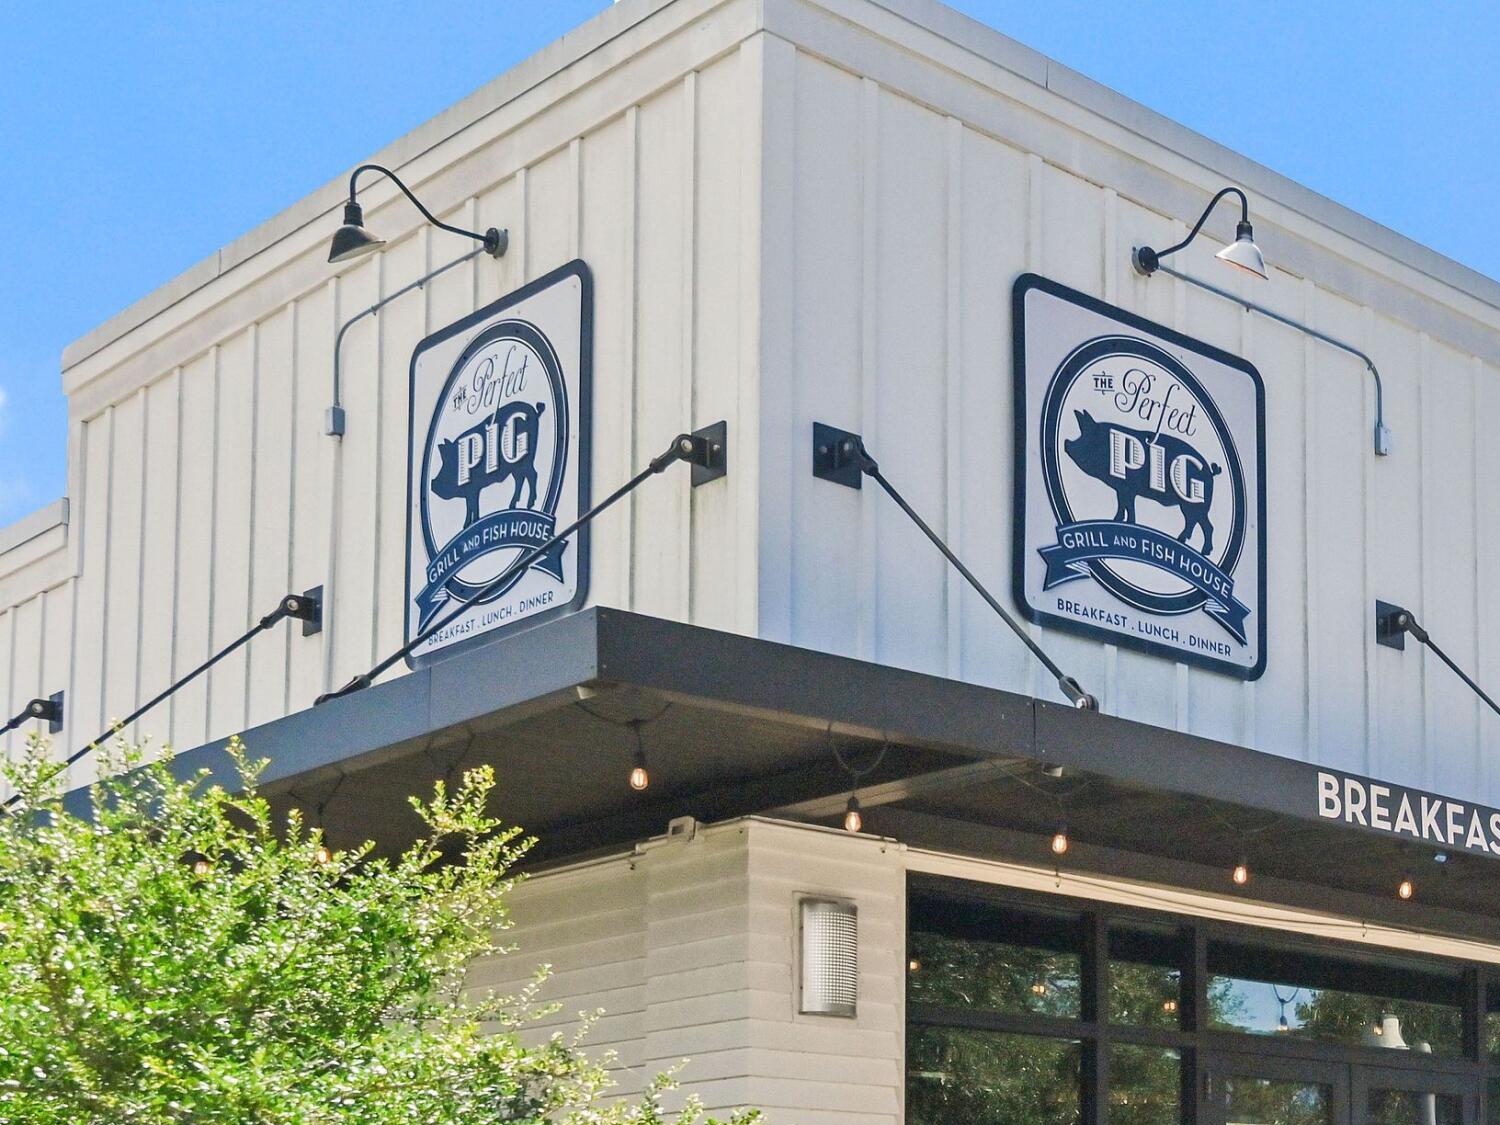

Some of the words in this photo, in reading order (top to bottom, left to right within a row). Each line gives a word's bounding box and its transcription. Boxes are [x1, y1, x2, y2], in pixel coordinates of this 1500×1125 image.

[453, 389, 467, 408] THE
[467, 345, 528, 430] Perfect
[1093, 377, 1114, 389] THE
[1114, 368, 1197, 444] Perfect
[458, 412, 529, 486] PIG
[1109, 428, 1205, 503] PIG
[429, 548, 460, 583] GRILL
[463, 535, 480, 553] AND
[483, 523, 508, 544] FISH
[510, 520, 550, 541] HOUSE
[1063, 531, 1109, 549] GRILL
[1113, 536, 1137, 549] AND
[1142, 539, 1175, 564] FISH
[1180, 556, 1231, 599] HOUSE
[428, 619, 476, 646] BREAKFAST
[482, 605, 512, 626] LUNCH
[519, 591, 554, 613] DINNER
[1057, 598, 1128, 628] BREAKFAST
[1138, 620, 1179, 643] LUNCH
[1189, 635, 1232, 657] DINNER
